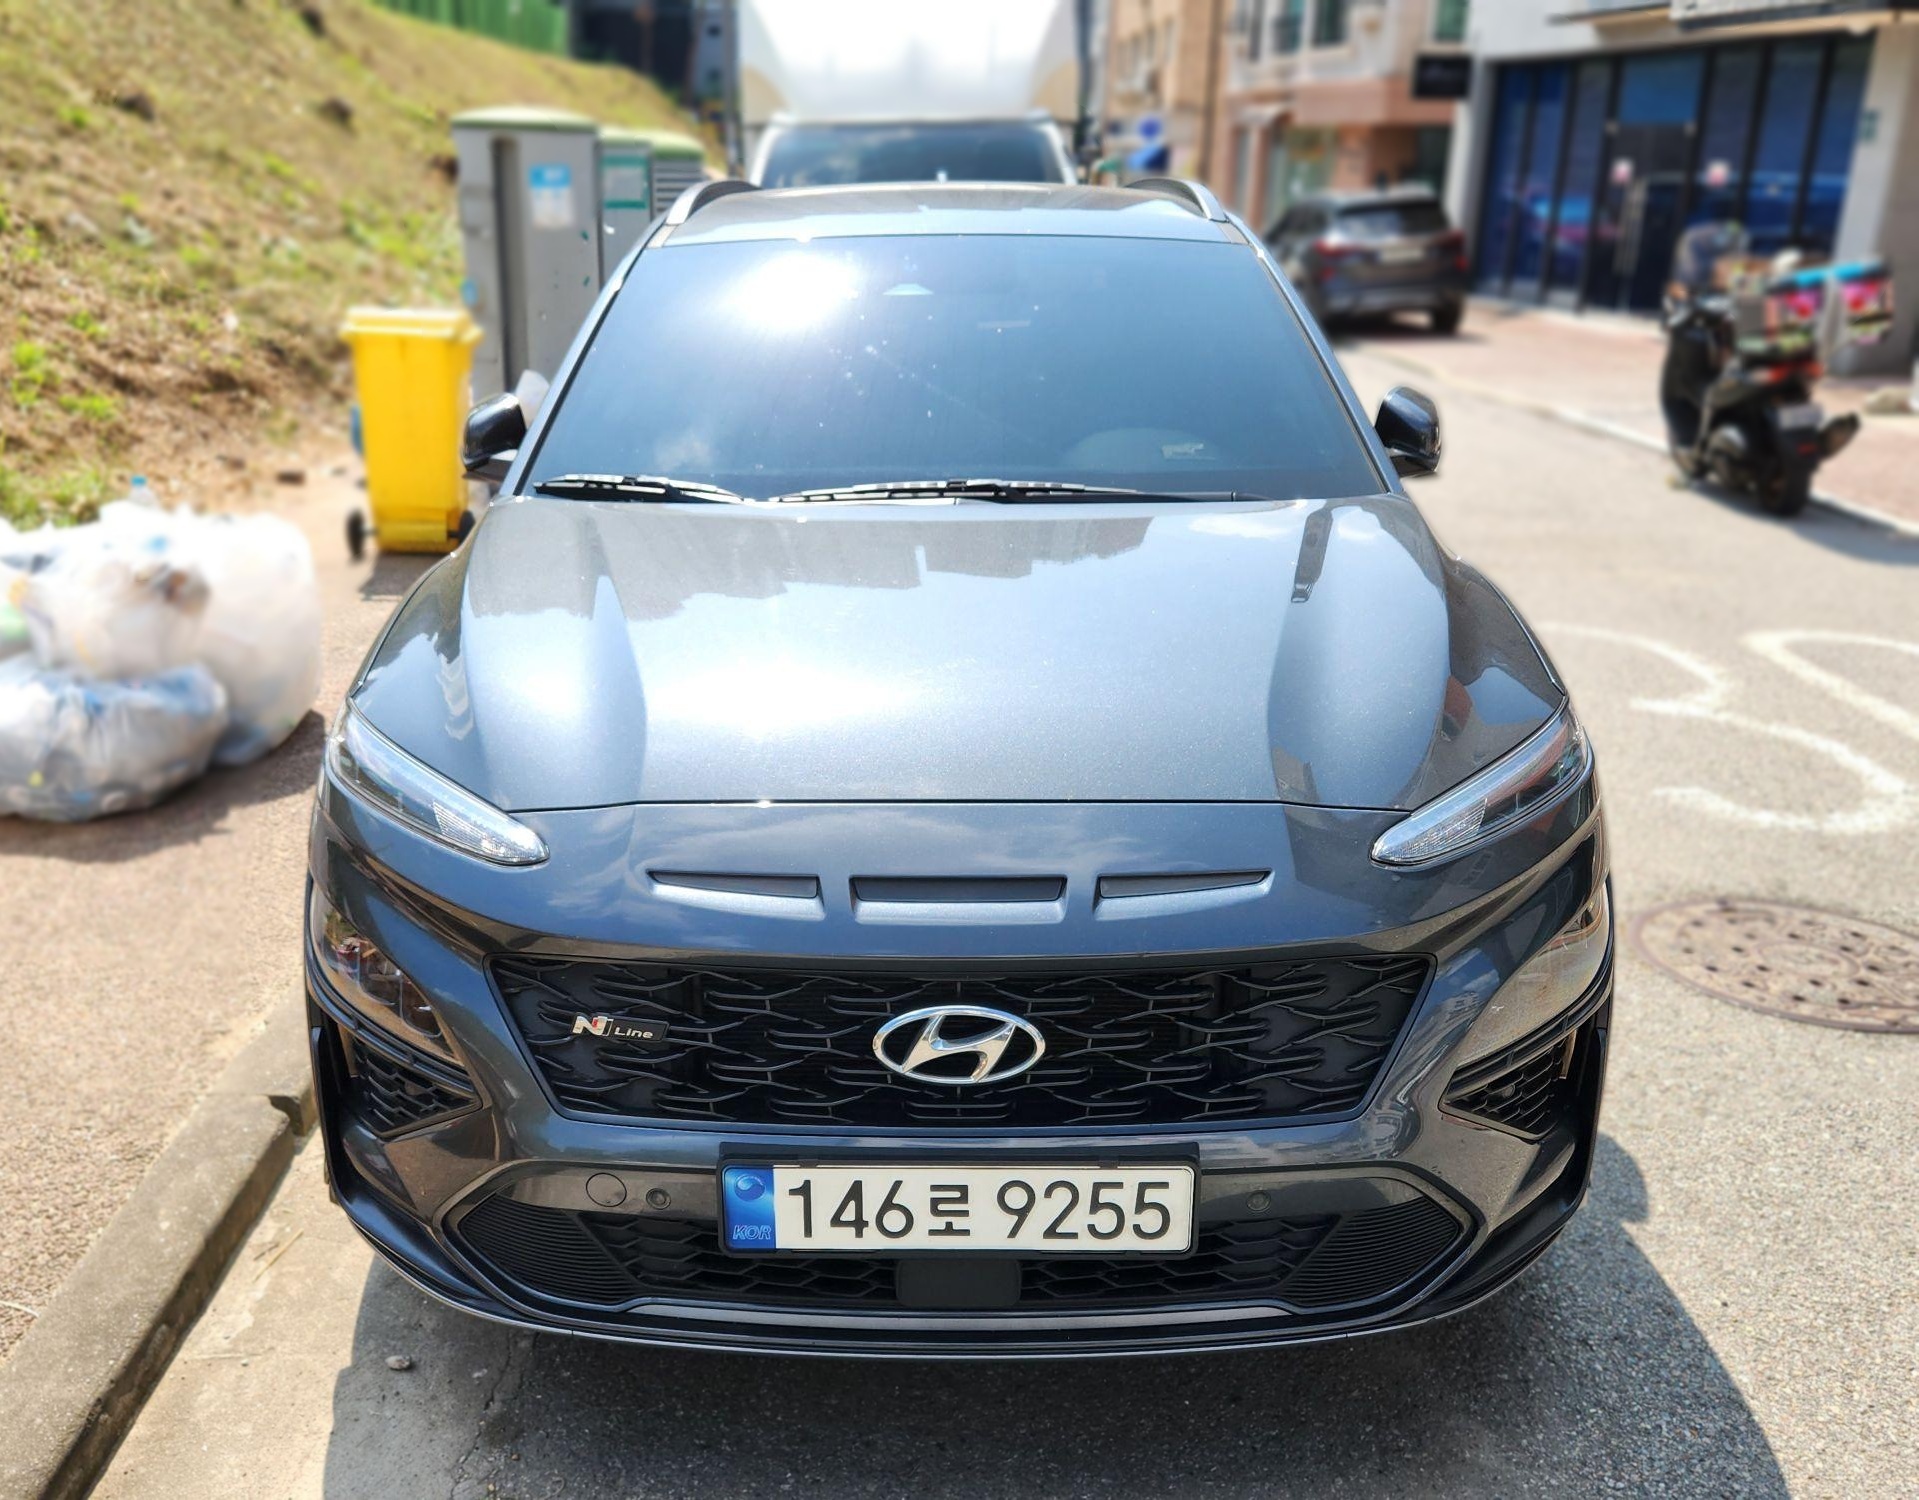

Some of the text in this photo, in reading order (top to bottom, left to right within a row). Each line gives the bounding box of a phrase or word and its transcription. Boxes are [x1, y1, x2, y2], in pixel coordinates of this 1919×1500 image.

[614, 1026, 654, 1039] Line
[788, 1179, 1171, 1240] 146로 9255
[732, 1224, 772, 1240] KOR
